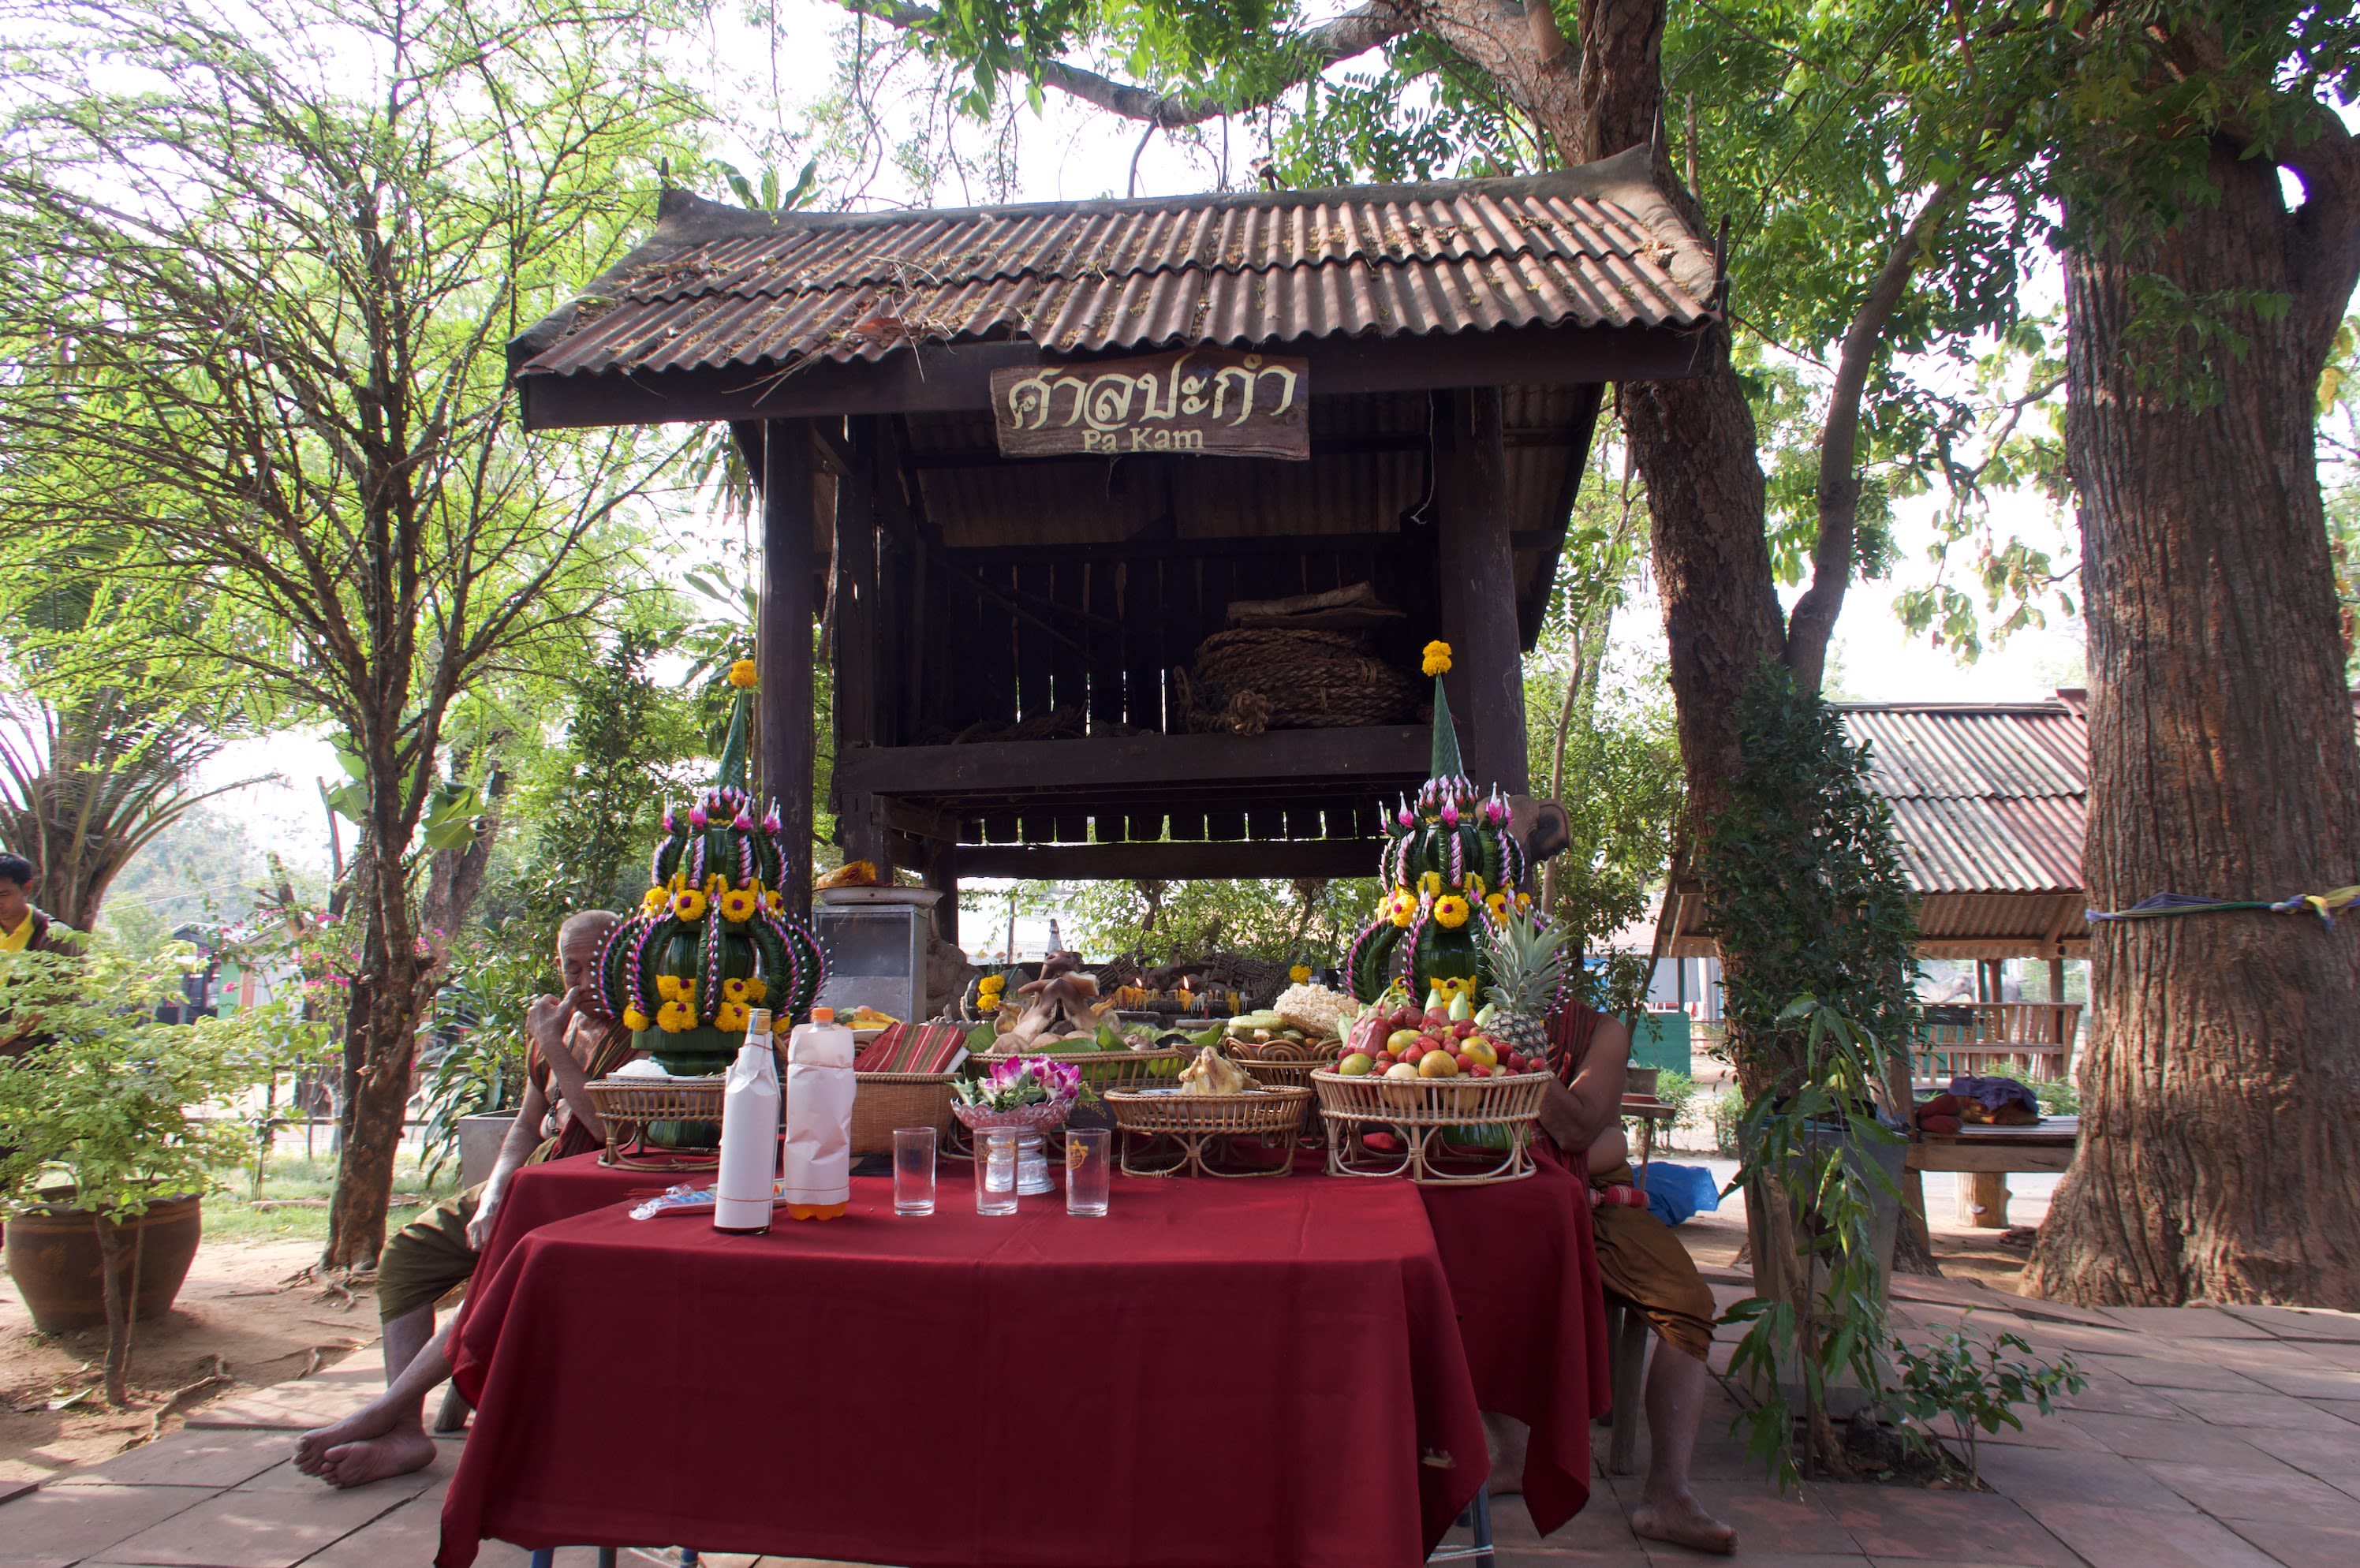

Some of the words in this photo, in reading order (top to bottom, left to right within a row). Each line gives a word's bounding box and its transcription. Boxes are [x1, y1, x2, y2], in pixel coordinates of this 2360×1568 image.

[1009, 352, 1298, 430] ศาลปะกำ
[1081, 429, 1118, 454] Pa
[1130, 427, 1204, 452] Kam
